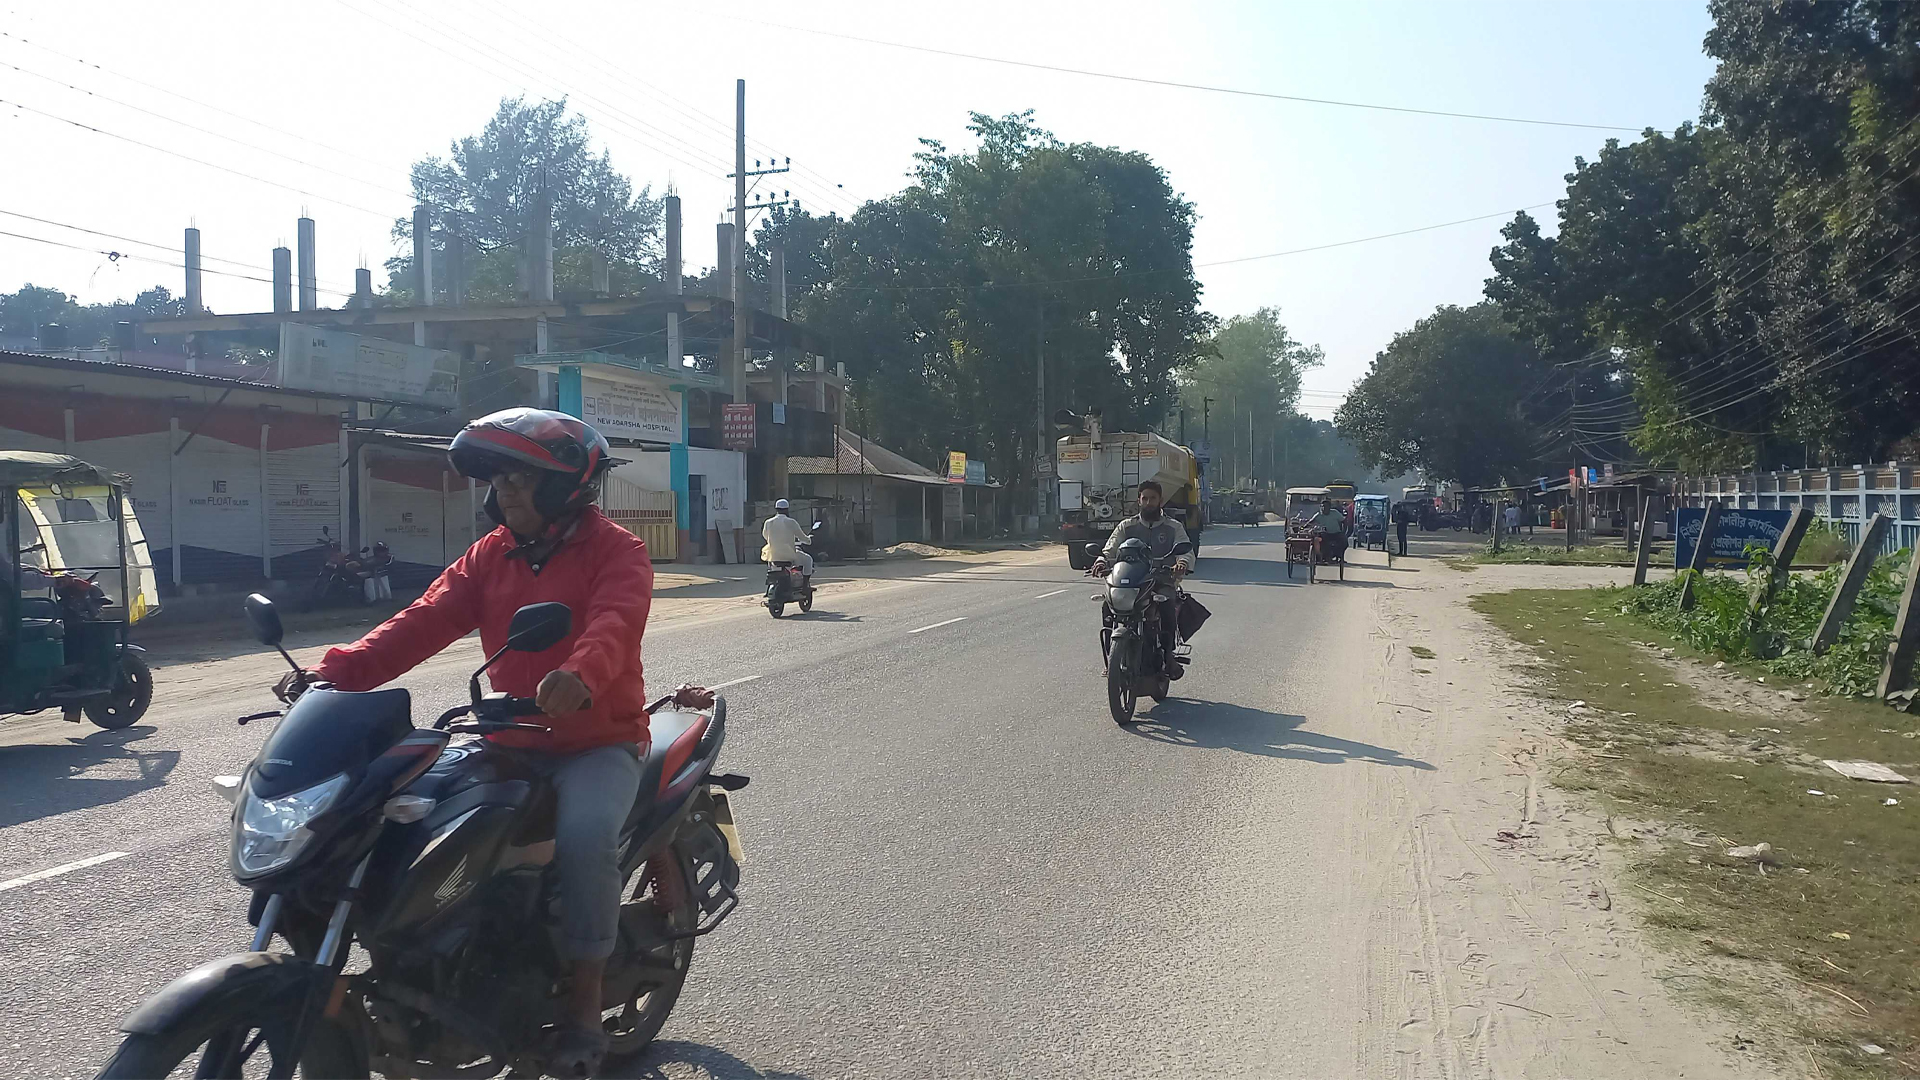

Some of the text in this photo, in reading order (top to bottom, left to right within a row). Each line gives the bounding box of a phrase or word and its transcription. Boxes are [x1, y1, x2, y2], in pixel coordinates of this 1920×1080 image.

[597, 417, 611, 425] NEW
[612, 420, 641, 429] ADARSHA
[208, 497, 232, 507] FLOAT
